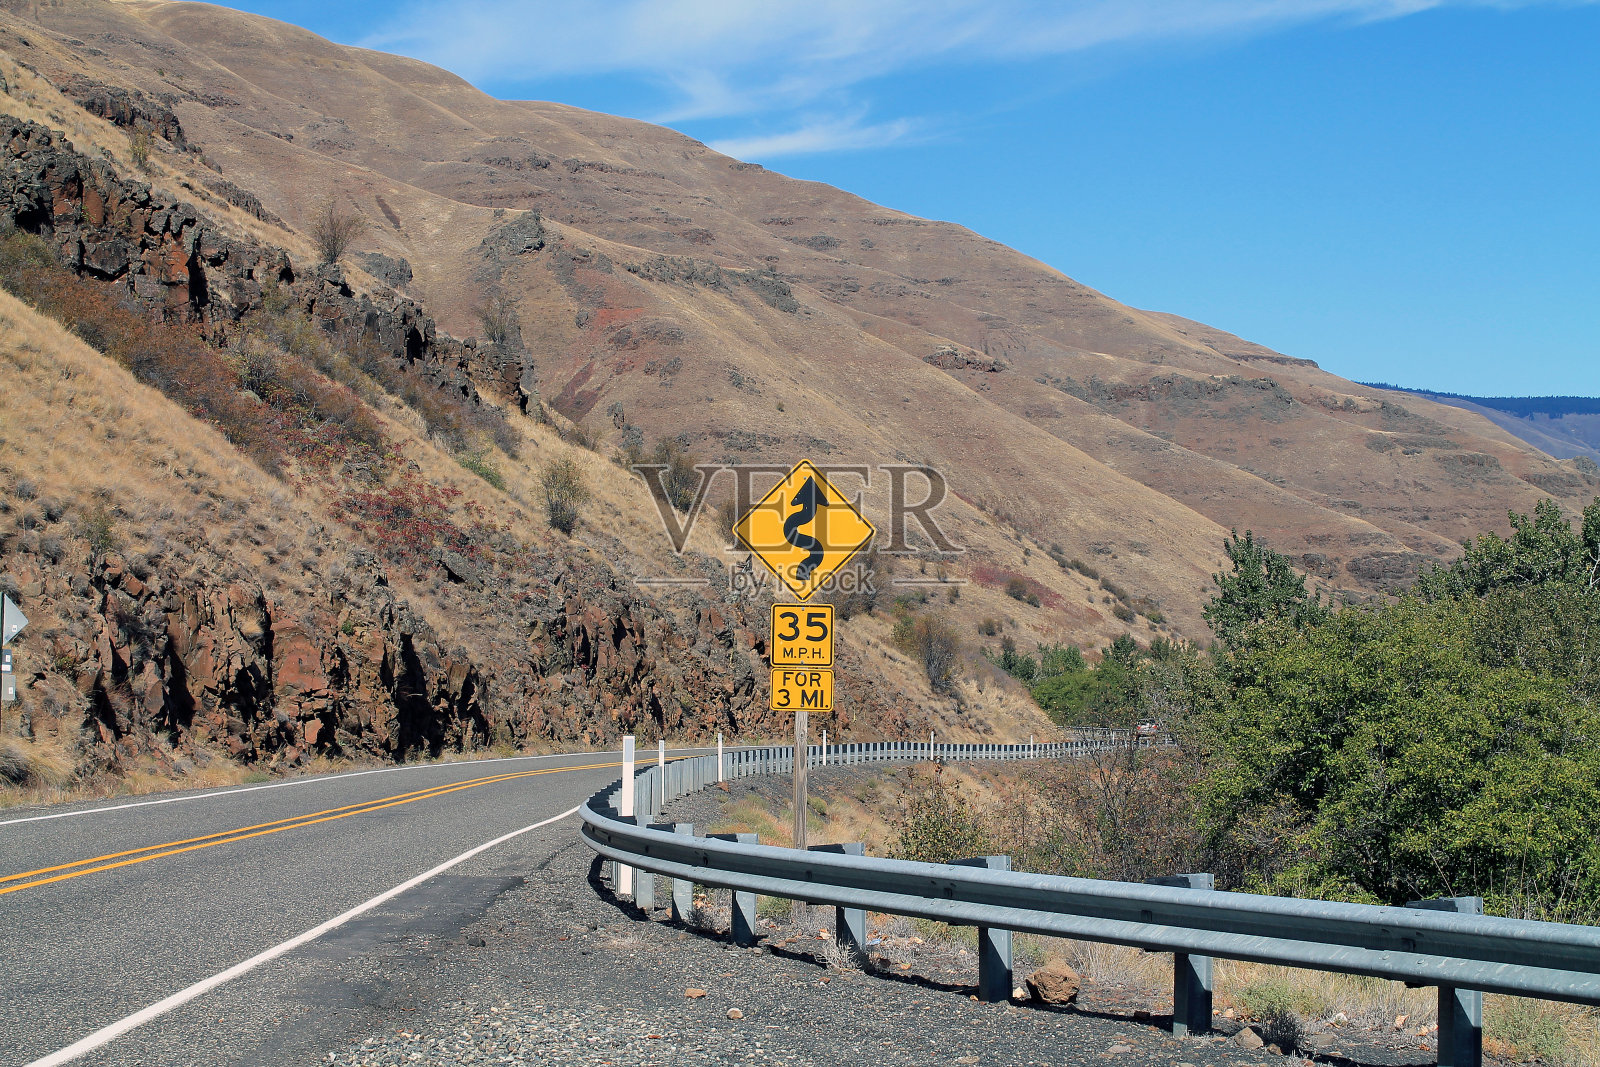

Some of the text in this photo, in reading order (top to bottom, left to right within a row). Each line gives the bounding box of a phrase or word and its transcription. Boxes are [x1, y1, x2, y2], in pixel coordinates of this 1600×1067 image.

[777, 612, 828, 642] 35
[783, 647, 825, 659] M.P.H.
[782, 672, 822, 687] FOR
[776, 689, 829, 708] 3 MI.
